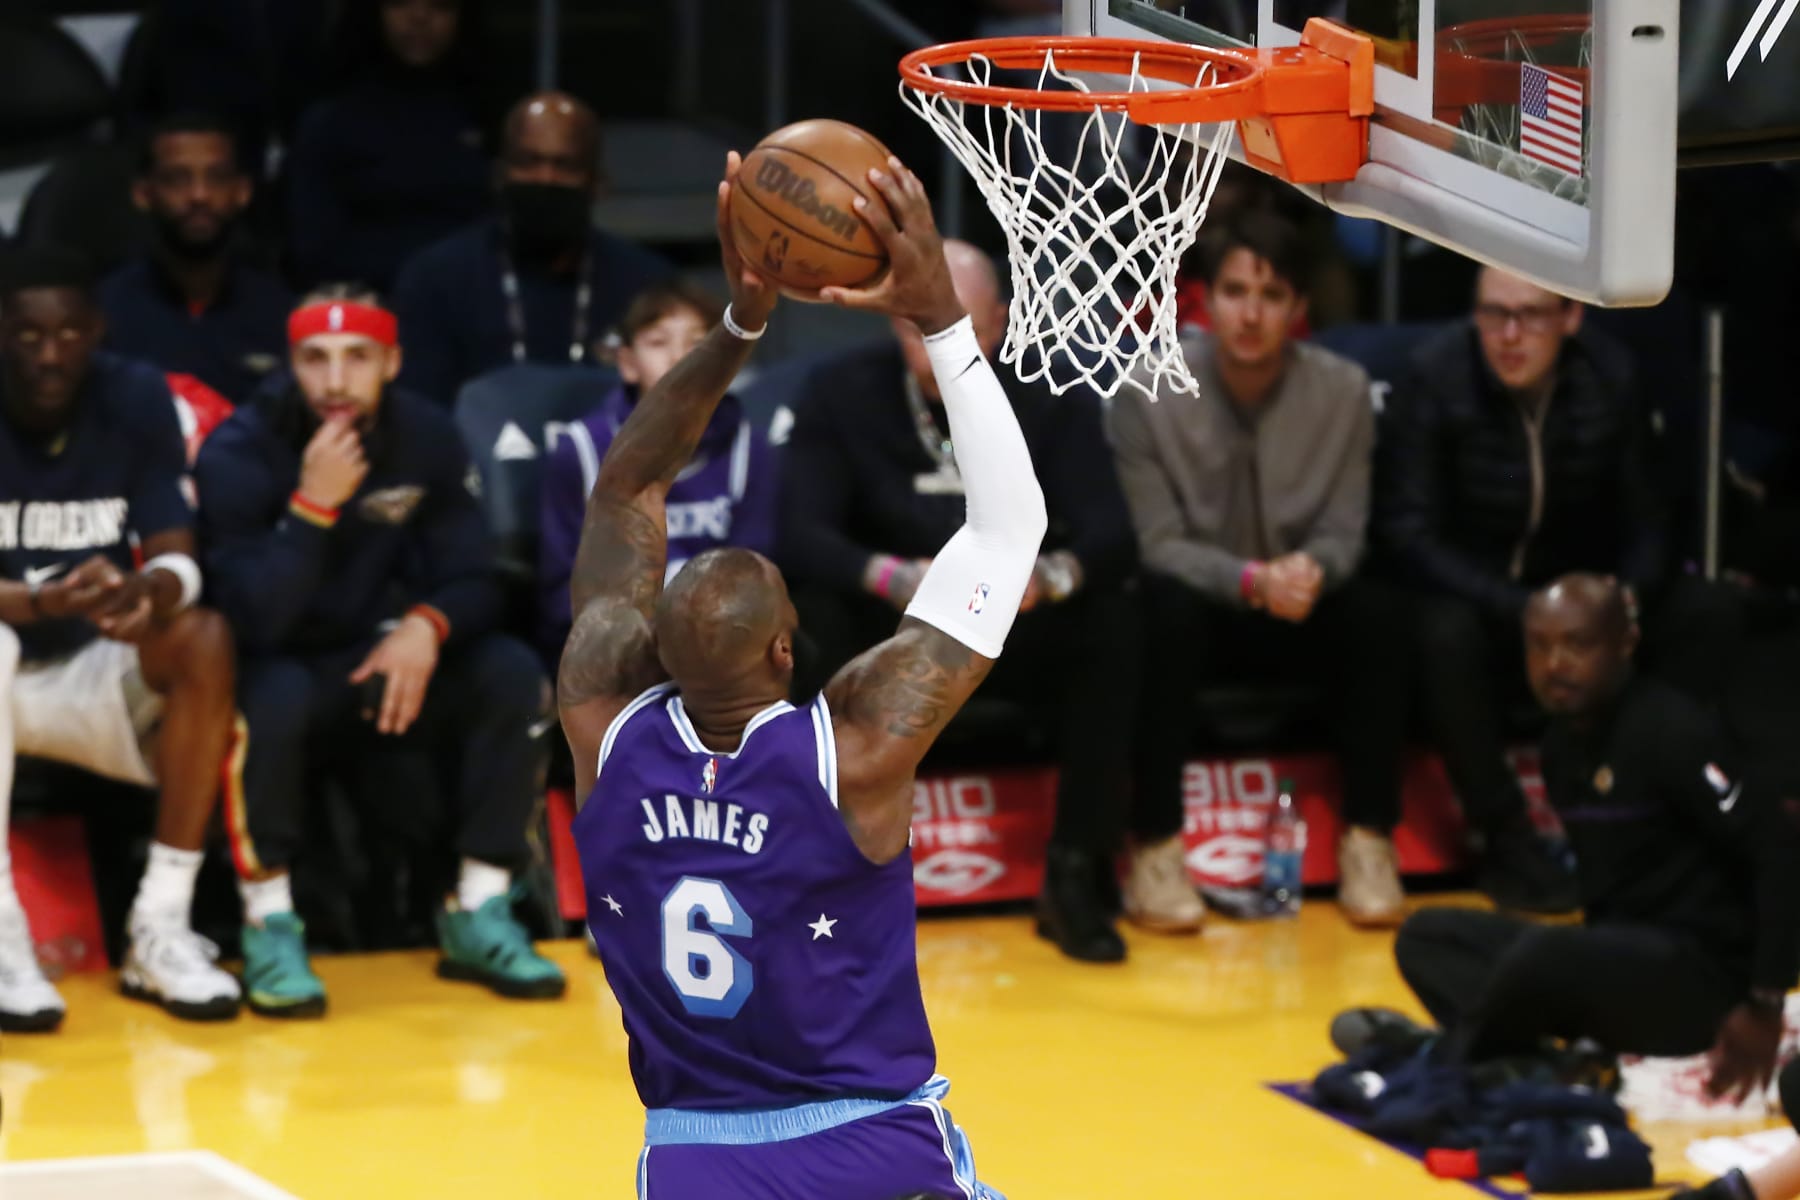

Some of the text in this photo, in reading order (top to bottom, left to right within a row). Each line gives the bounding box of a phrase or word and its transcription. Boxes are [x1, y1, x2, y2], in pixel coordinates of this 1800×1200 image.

[756, 156, 860, 242] Wilson
[640, 794, 769, 854] JAMES
[660, 875, 754, 1019] 6
